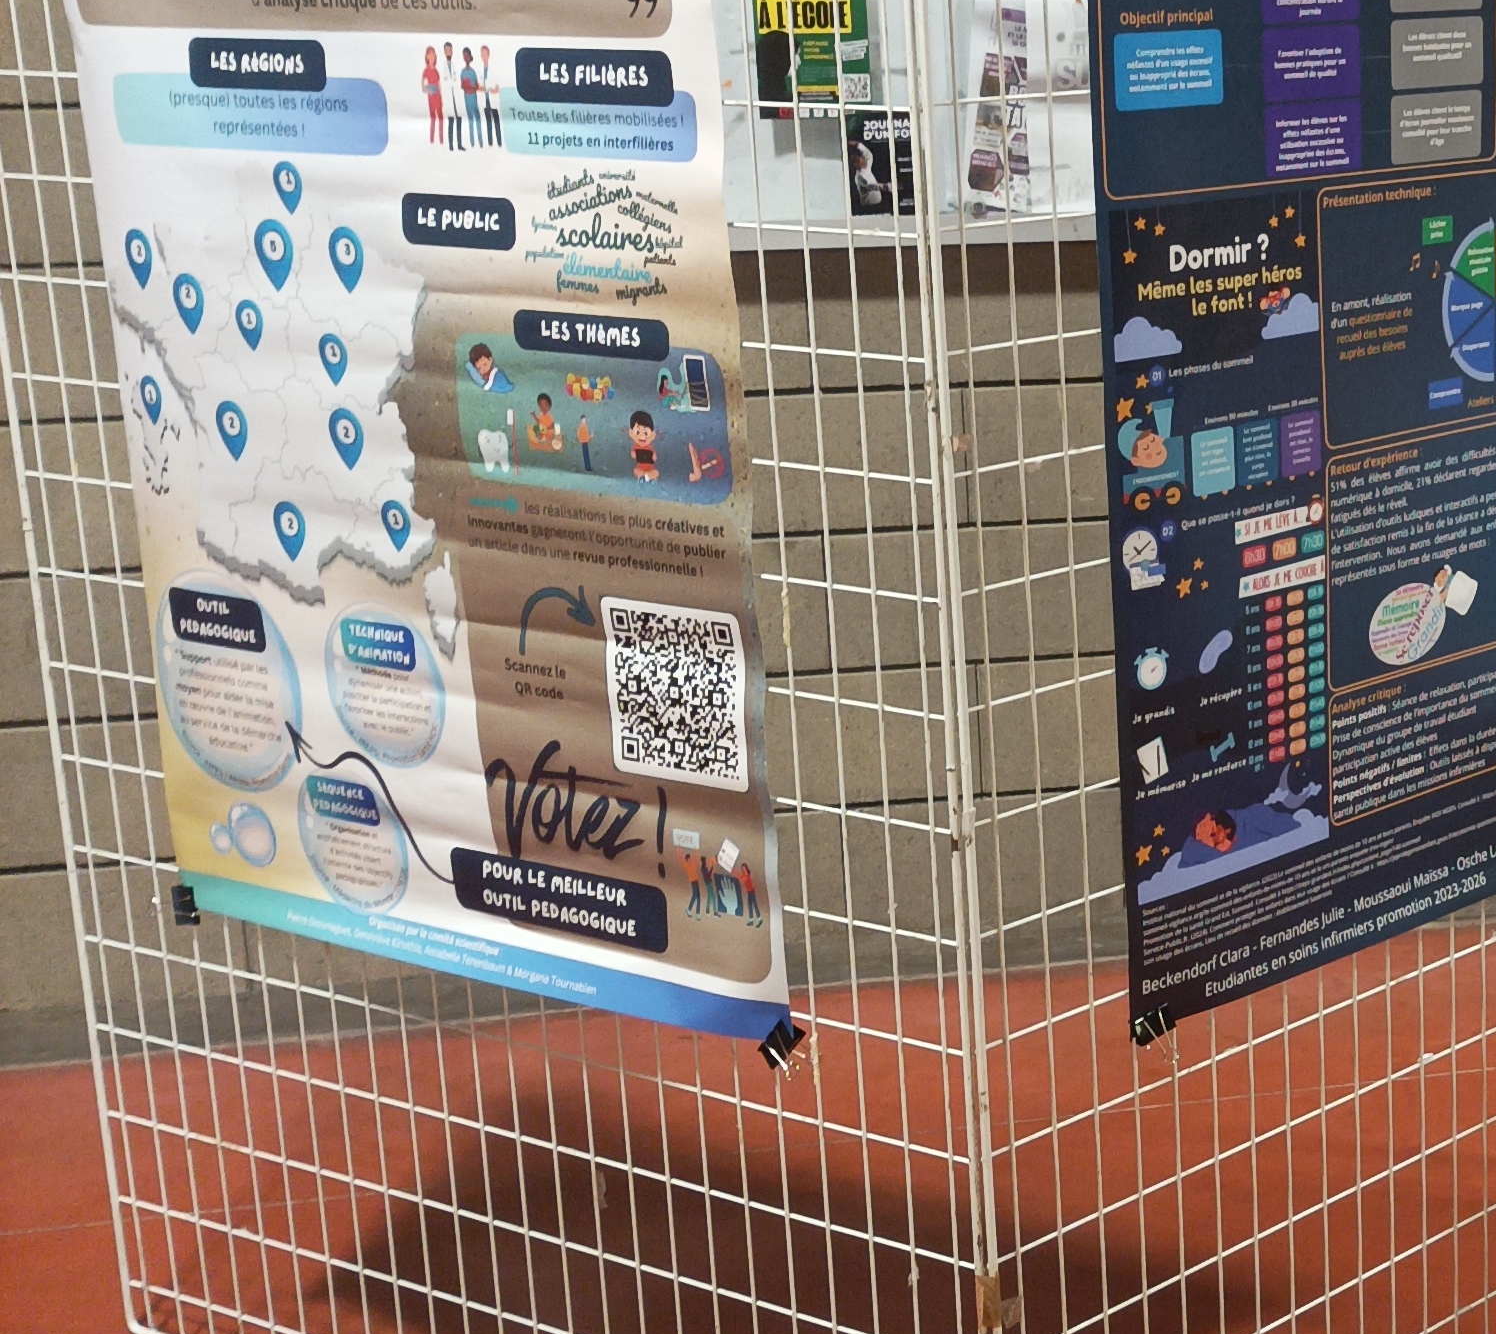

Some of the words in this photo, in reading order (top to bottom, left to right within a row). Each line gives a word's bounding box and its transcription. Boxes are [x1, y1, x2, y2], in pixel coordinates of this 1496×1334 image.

[1119, 10, 1165, 27] Objectif
[1167, 7, 1214, 26] principal
[210, 51, 237, 72] LES
[539, 62, 569, 85] LES
[169, 90, 230, 113] (presque)
[233, 92, 275, 110] toutes
[278, 93, 296, 110] les
[300, 94, 348, 116] régions
[213, 120, 298, 141] représentées
[301, 122, 306, 138] !
[527, 132, 539, 145] 11
[542, 133, 584, 151] projets
[586, 138, 600, 148] en
[603, 135, 674, 151] interfilières
[548, 184, 632, 221] associations
[417, 207, 437, 227] LE
[441, 210, 500, 232] PUBLIC
[617, 203, 672, 234] collégiens
[556, 213, 655, 254] scolaires
[1169, 236, 1252, 272] Dormir
[1257, 233, 1269, 260] ?
[556, 269, 600, 294] femmes
[616, 277, 668, 306] migrants
[1138, 276, 1186, 302] Même
[1190, 275, 1213, 295] les
[1217, 272, 1258, 295] super
[1262, 265, 1303, 285] héros
[1192, 298, 1207, 317] le
[1210, 294, 1246, 314] font
[1247, 292, 1253, 309] !
[541, 319, 571, 342] LES
[196, 598, 230, 616] OUTIL
[504, 657, 553, 678] Scannez
[555, 665, 566, 679] le
[514, 680, 533, 696] QR
[535, 683, 564, 700] code
[484, 739, 645, 860] Votez
[657, 785, 667, 879] !
[482, 860, 523, 886] POUR
[528, 868, 546, 889] LE
[550, 872, 627, 907] MEILLEUR
[483, 886, 526, 913] OUTIL
[531, 896, 637, 938] PEDAGOGIQUE
[1141, 952, 1218, 996] Beckendorf
[1219, 941, 1251, 969] Clara
[1259, 915, 1319, 955] Fernandes
[1320, 905, 1346, 931] Julie
[1353, 879, 1412, 919] Moussaoui
[1414, 865, 1449, 896] Maïssa
[1456, 848, 1487, 879] Osche
[1205, 957, 1269, 997] Etudiantes
[1271, 954, 1287, 972] en
[1289, 938, 1319, 965] soins
[1321, 916, 1374, 953] infirmiers
[1377, 894, 1432, 935] promotion
[1434, 872, 1487, 909] 2023-2026
